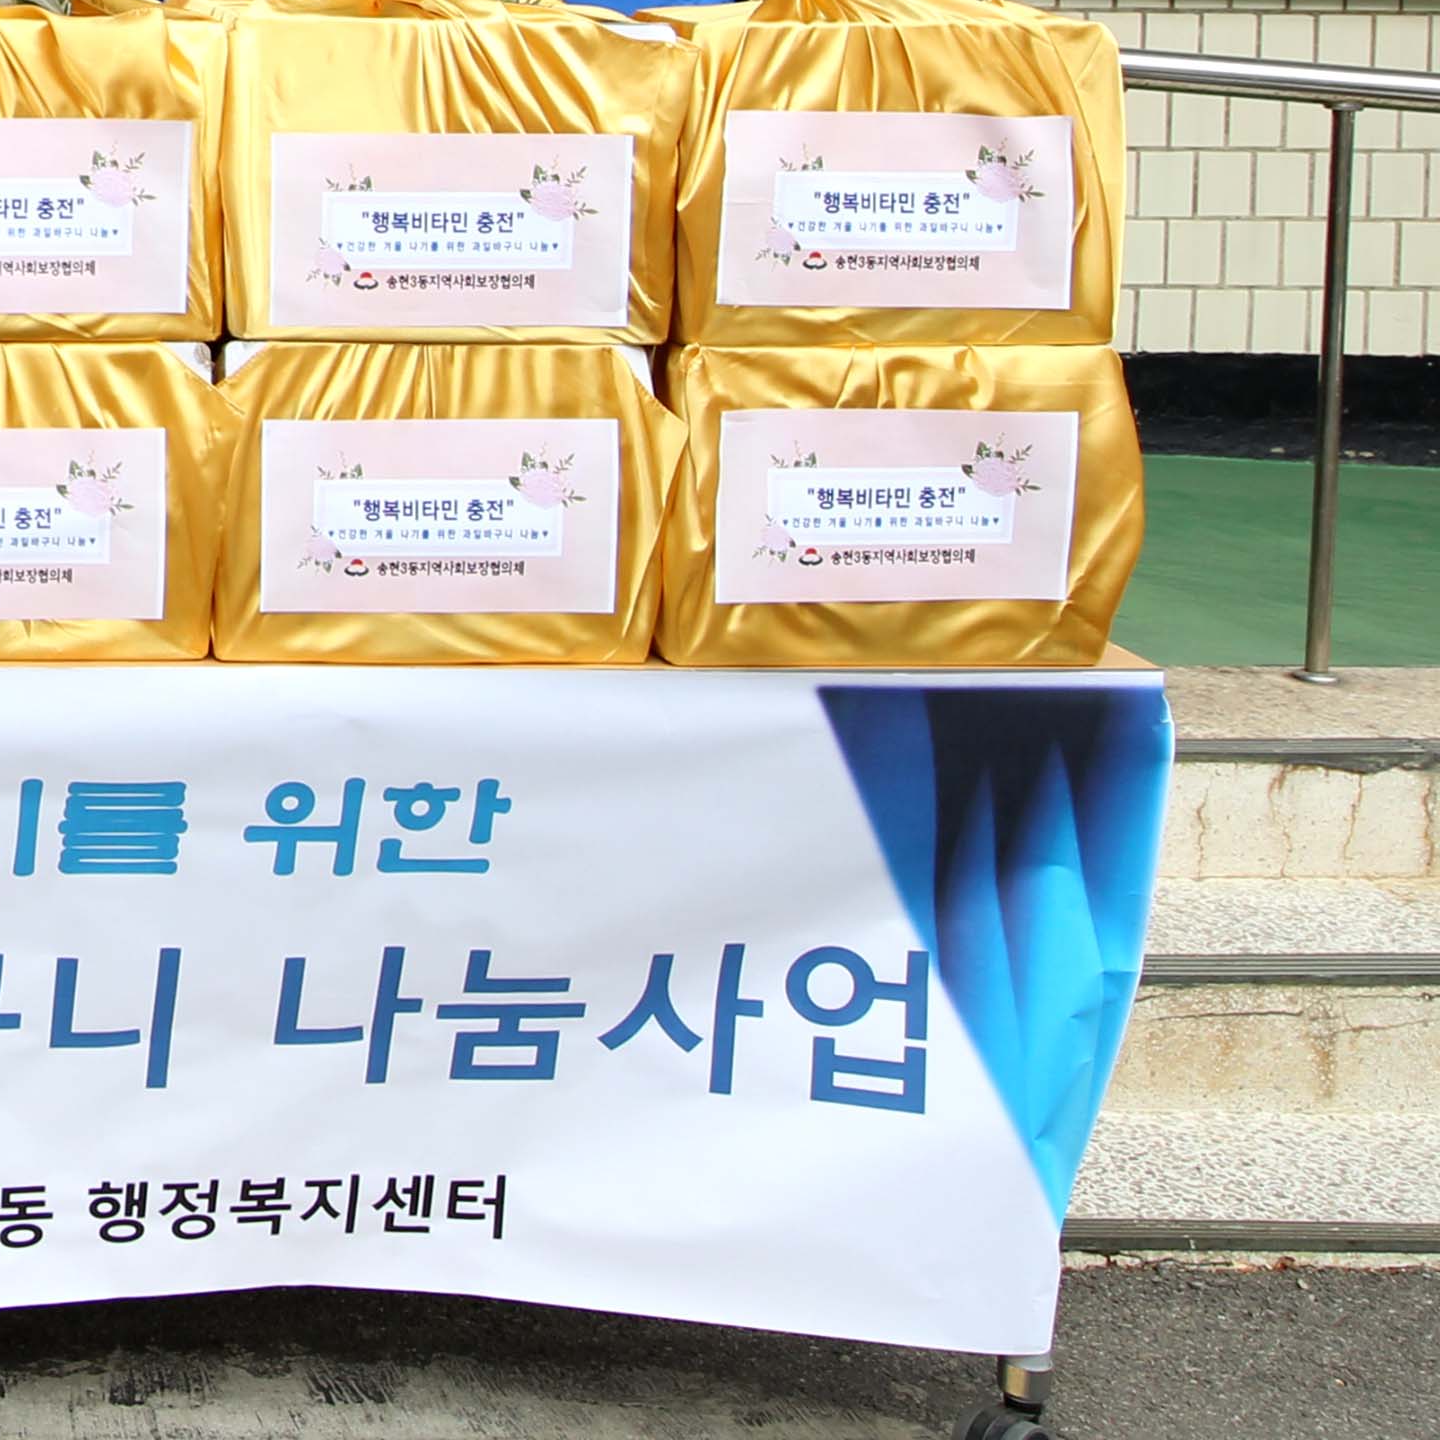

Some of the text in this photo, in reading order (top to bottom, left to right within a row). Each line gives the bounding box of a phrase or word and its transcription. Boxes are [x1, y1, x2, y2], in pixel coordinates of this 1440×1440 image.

[36, 197, 84, 221] 충전"
[923, 193, 970, 216] 충전"
[475, 211, 524, 235] 충전"
[835, 256, 980, 271] 송현3동지역사회보장협의체
[386, 274, 536, 290] 송현3동지역사회보장협의체
[918, 486, 966, 510] 충전"
[13, 507, 62, 530] 충전"
[466, 499, 514, 522] 충전"
[831, 548, 976, 566] 송현3동지역사회보장협의체
[377, 561, 525, 577] 송현3동지역사회보장협의체
[244, 778, 512, 876] 위한
[274, 942, 929, 1115] 나눔사업
[88, 1174, 506, 1243] 행정복지센터
